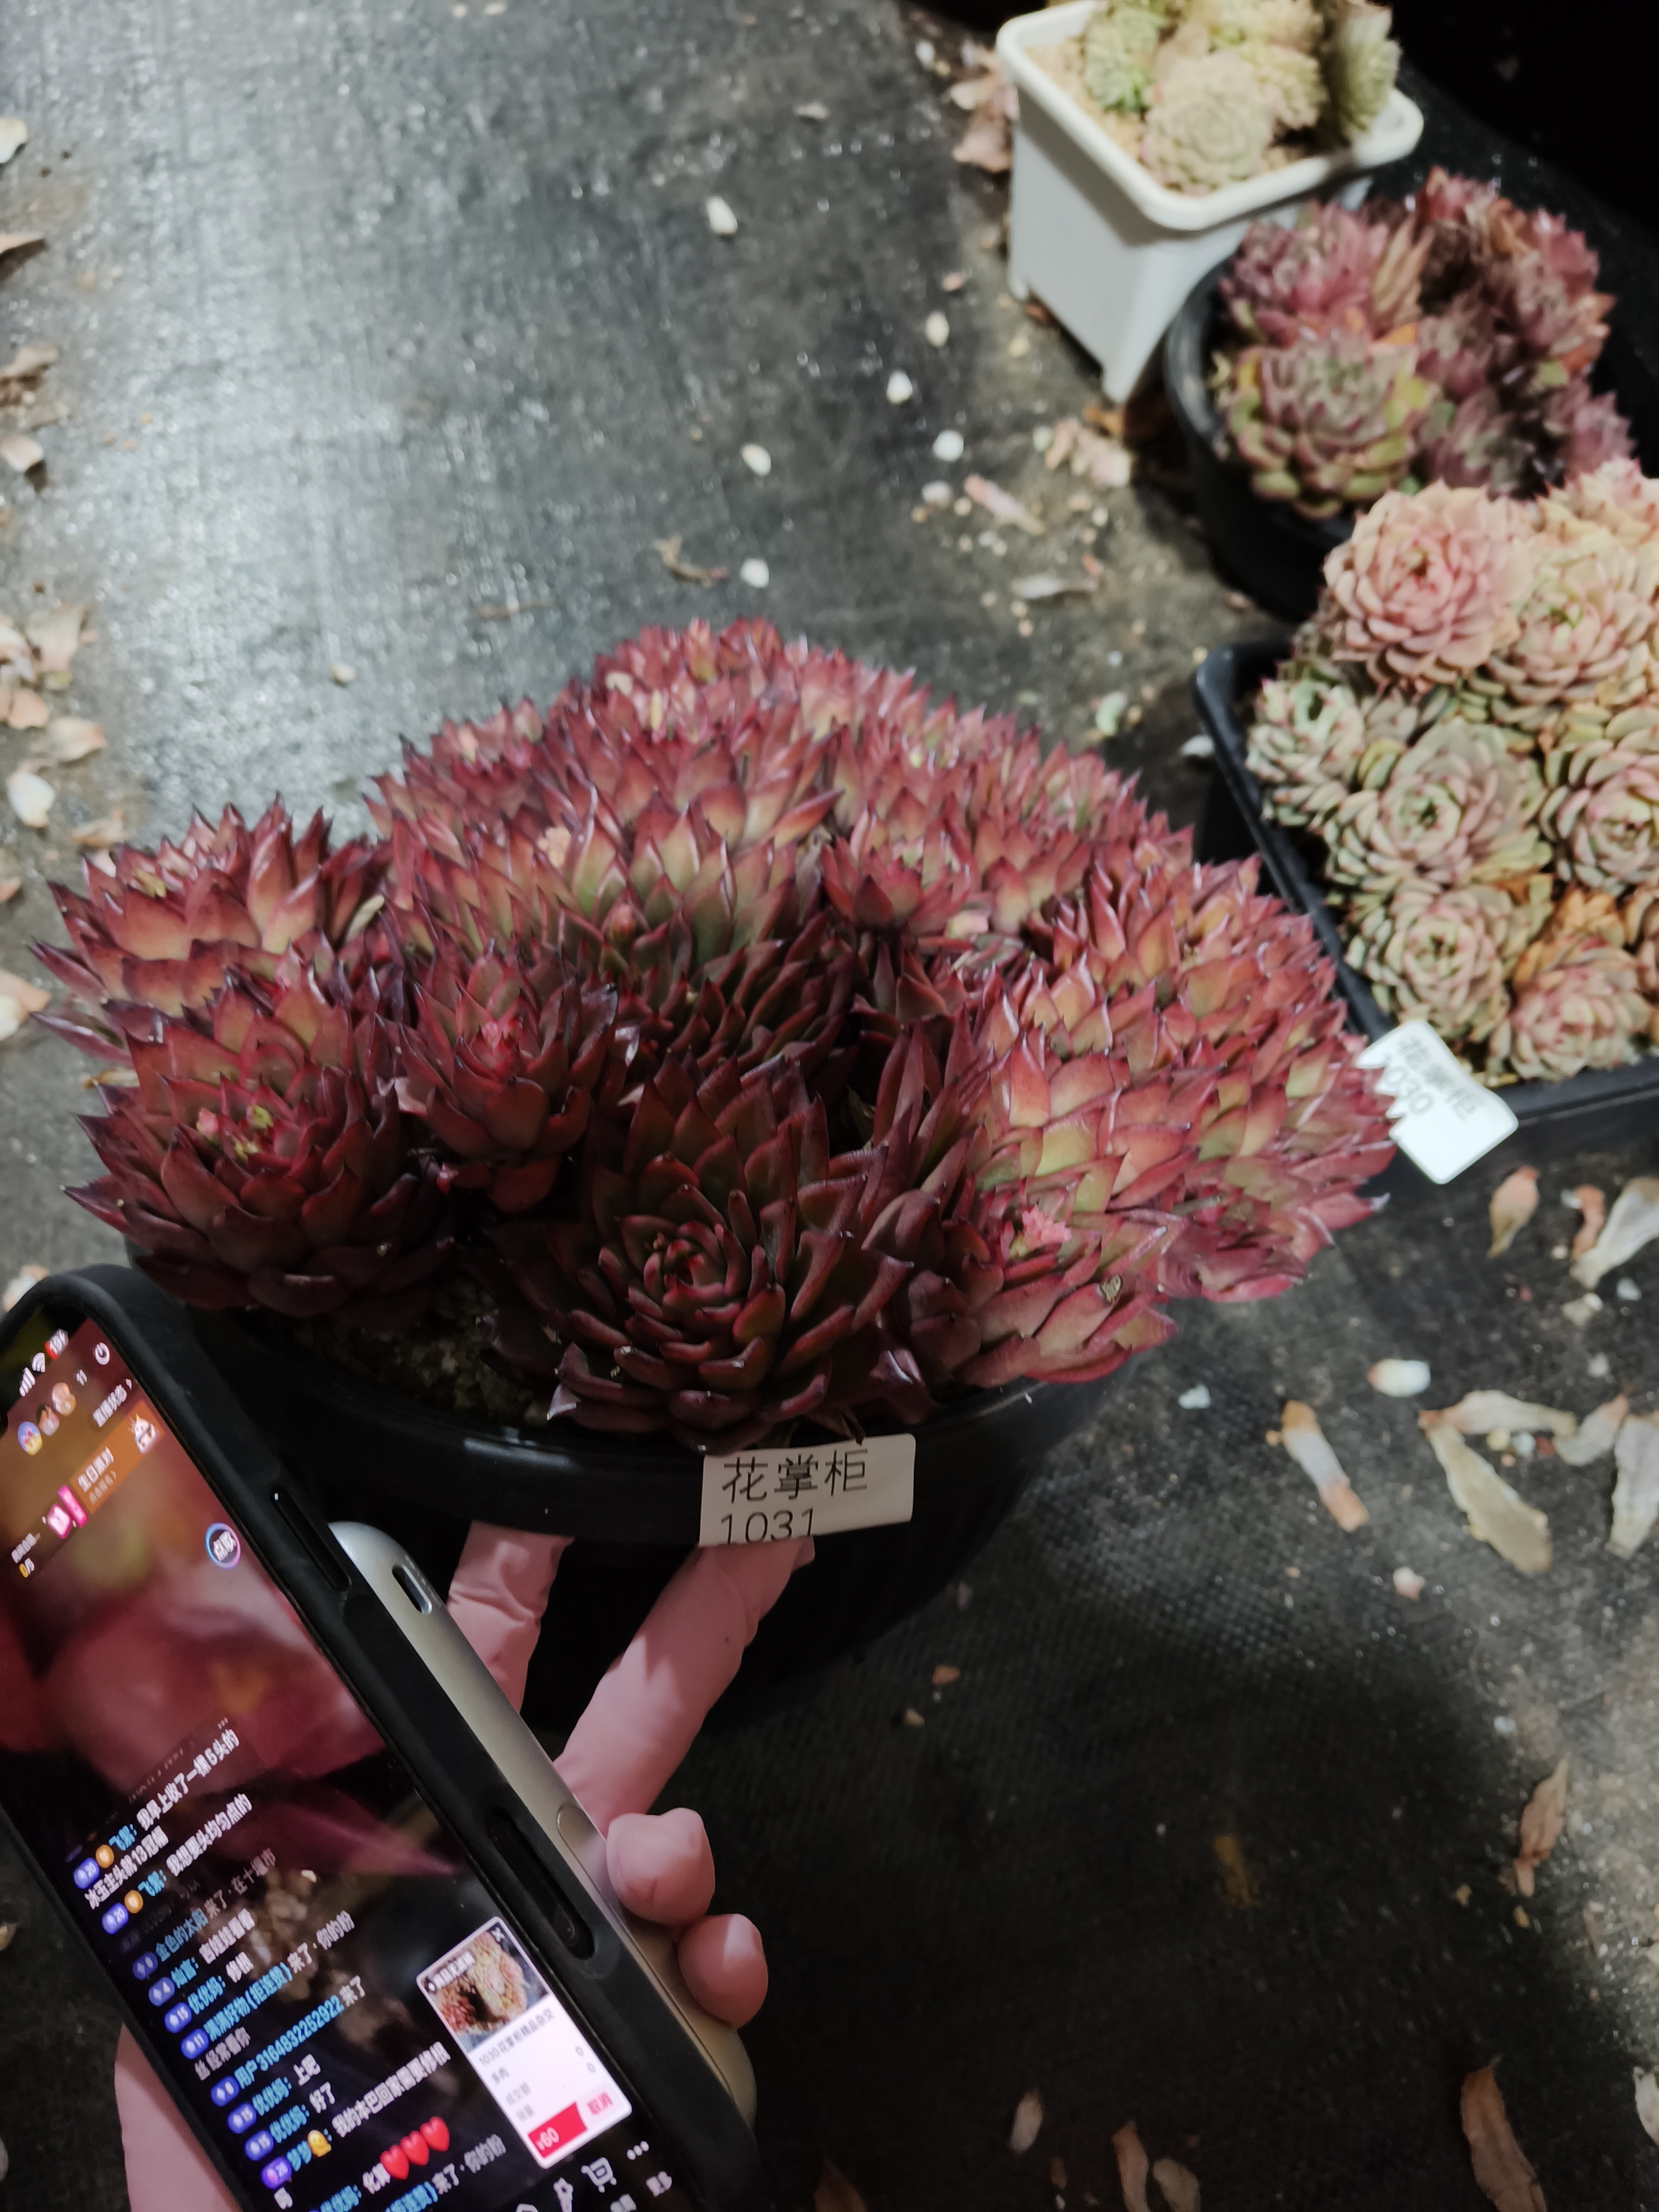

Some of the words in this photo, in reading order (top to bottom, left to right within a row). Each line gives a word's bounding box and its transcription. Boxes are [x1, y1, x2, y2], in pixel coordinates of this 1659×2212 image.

[721, 1449, 868, 1503] 花掌柜
[720, 1507, 813, 1545] 1031
[156, 1907, 209, 1962] 金色的太阳
[234, 1994, 345, 2088] 用户3164832252922
[339, 1975, 365, 2006] 来了
[293, 2054, 320, 2085] 上吧
[309, 2082, 335, 2113] 好了
